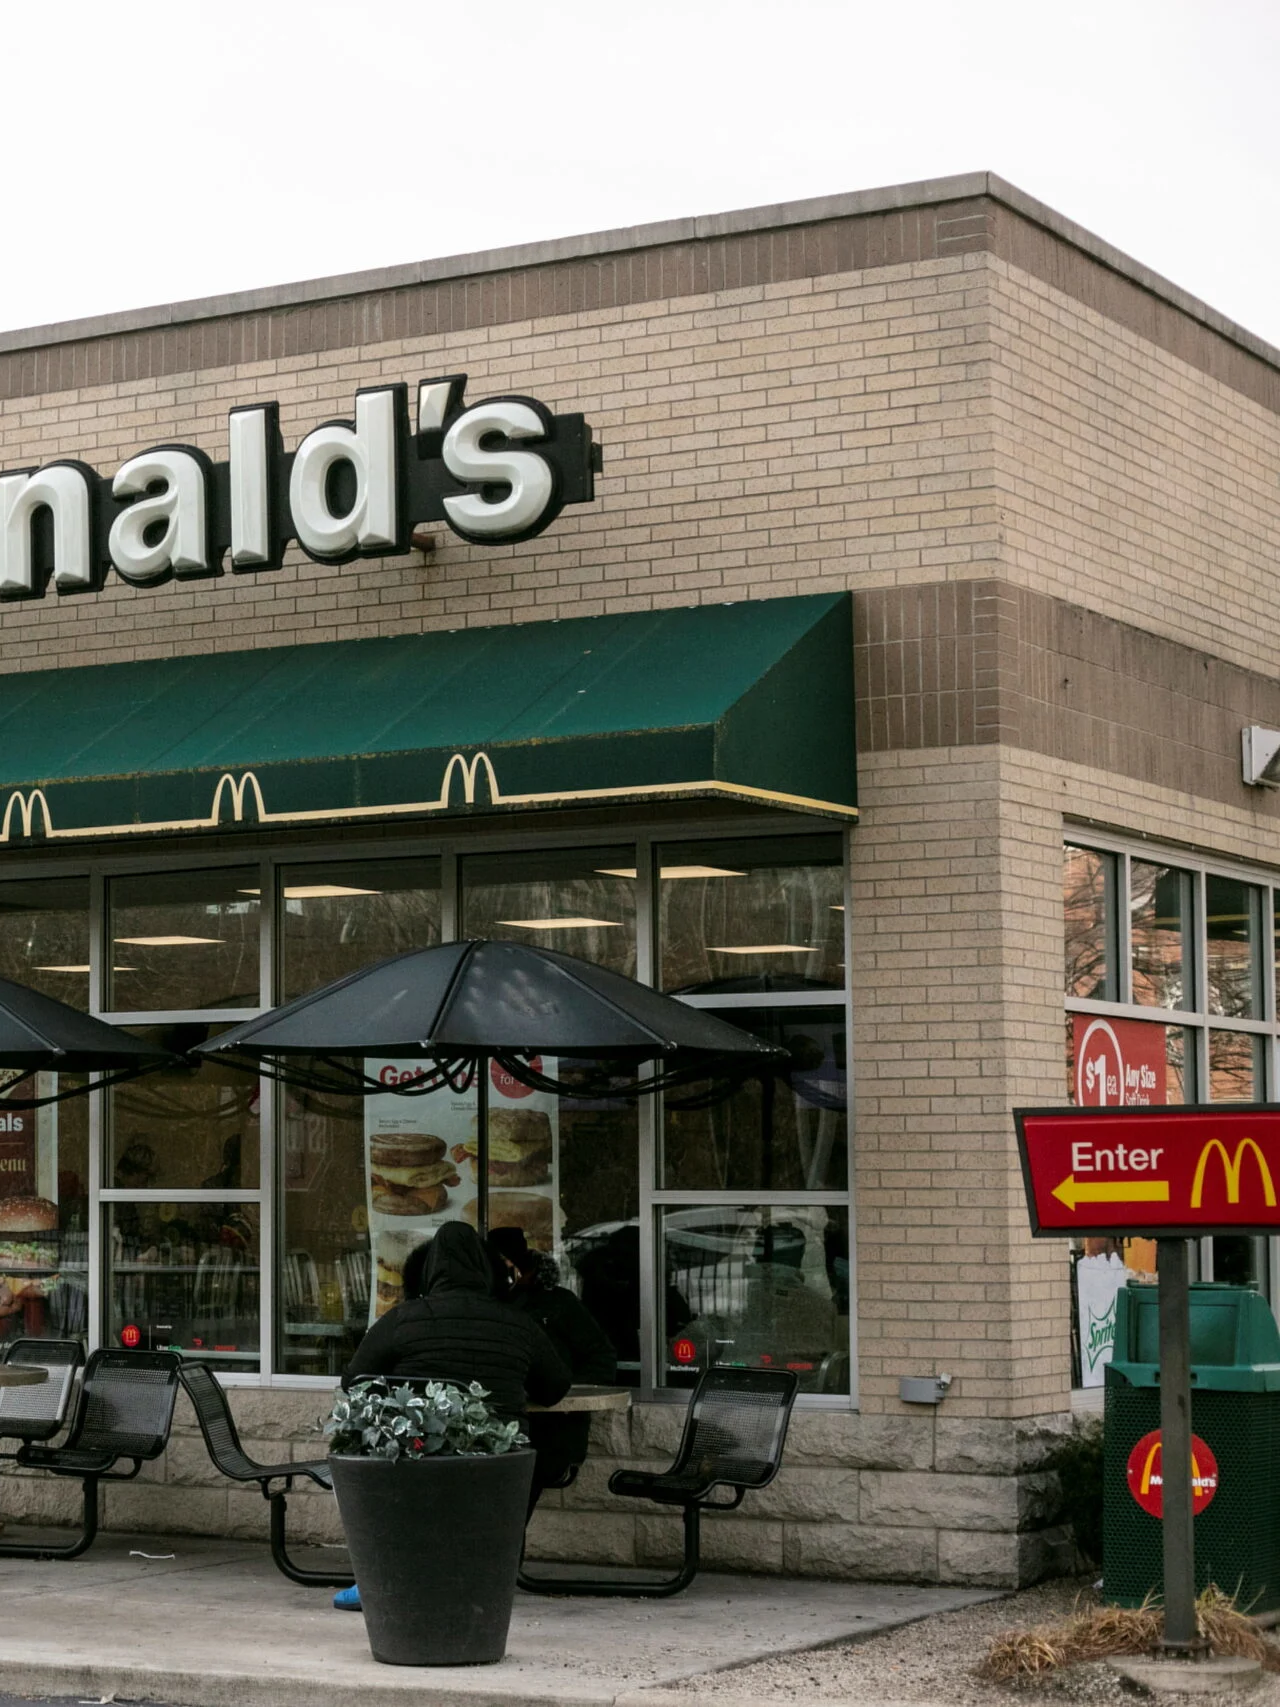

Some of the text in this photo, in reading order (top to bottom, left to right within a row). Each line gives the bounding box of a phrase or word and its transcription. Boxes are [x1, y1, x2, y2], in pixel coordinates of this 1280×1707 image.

[1125, 1063, 1140, 1094] Any
[1140, 1063, 1156, 1089] Size
[1071, 1142, 1164, 1171] Enter
